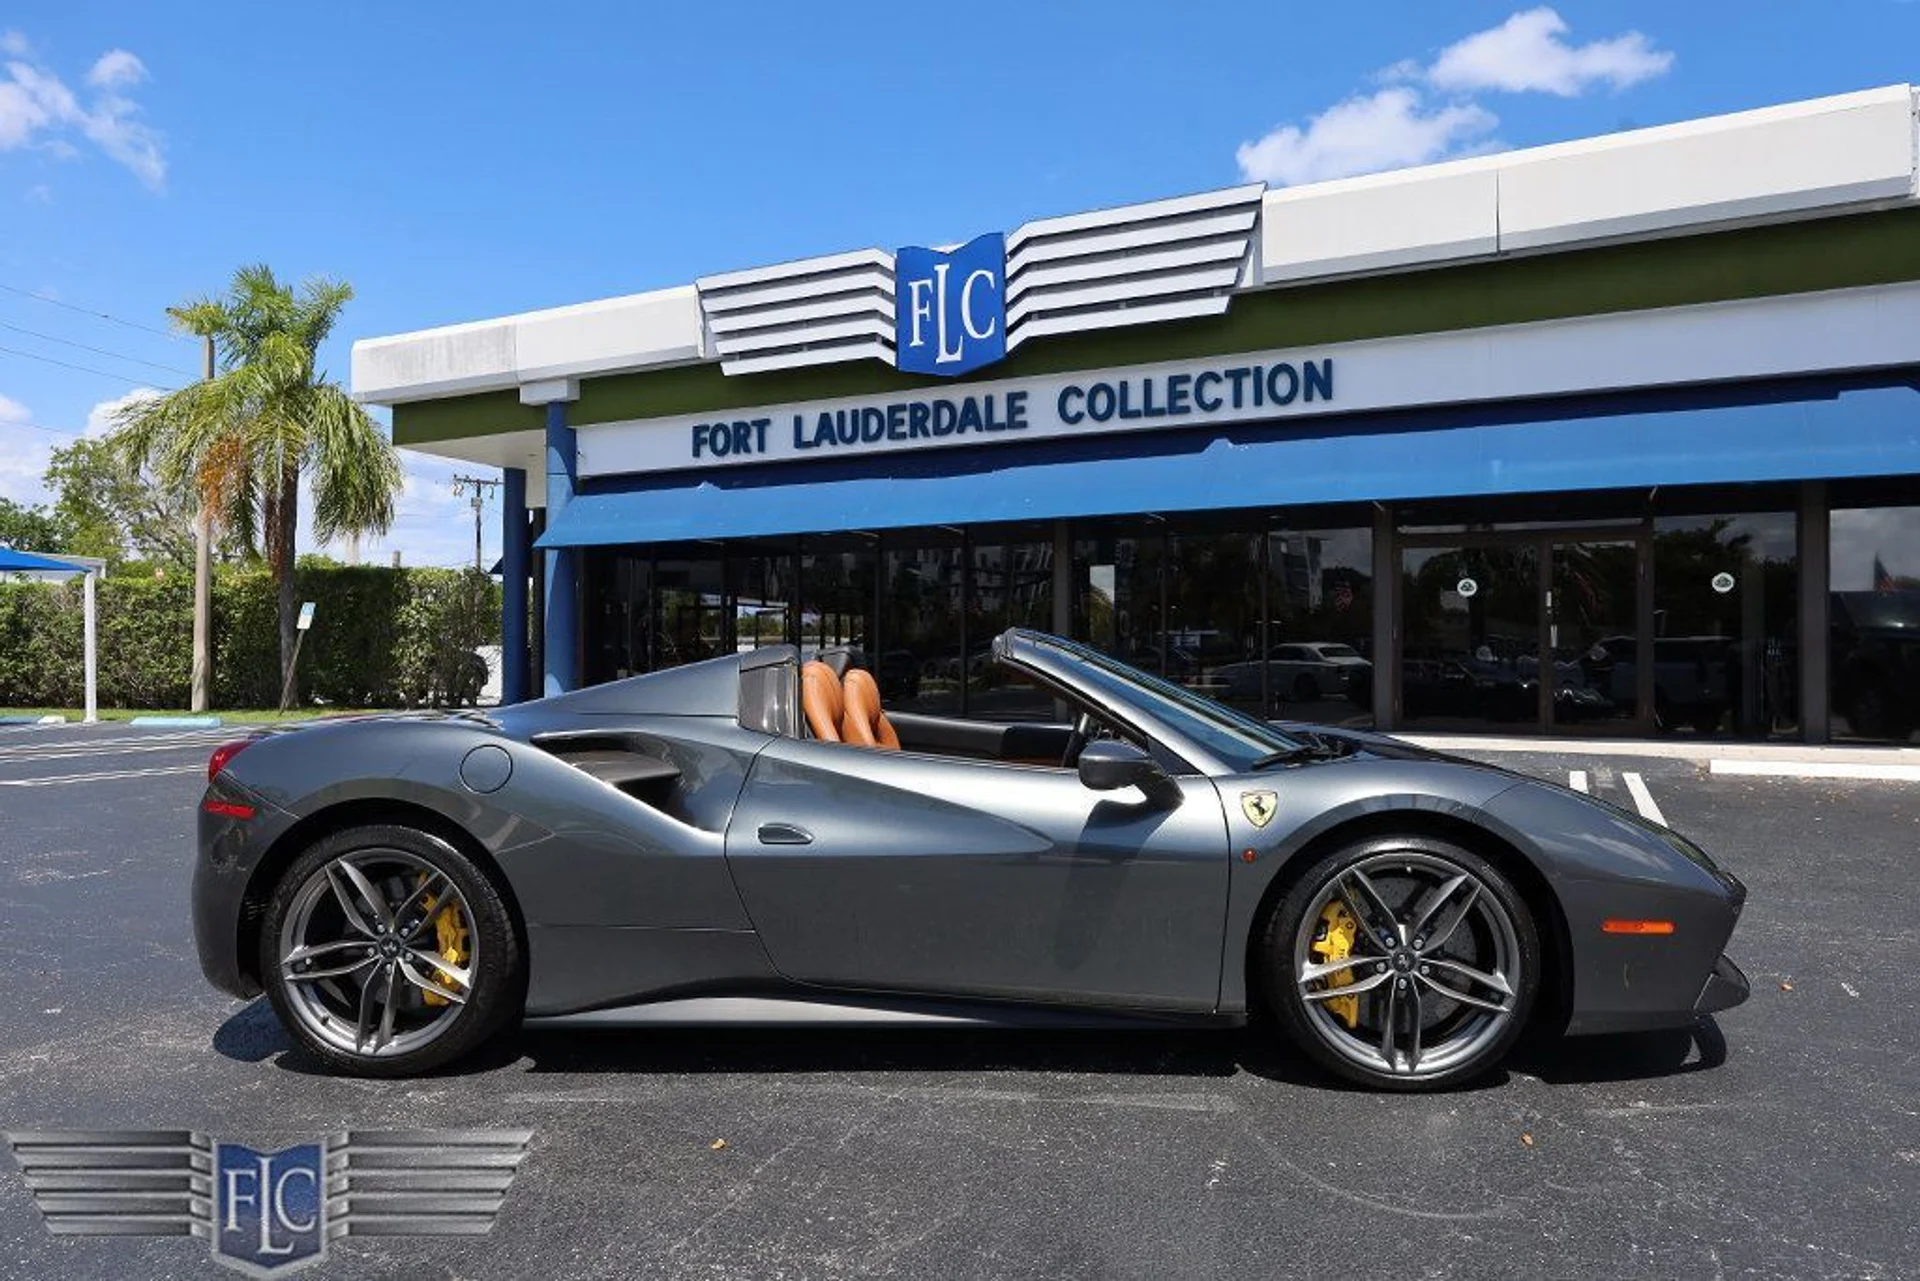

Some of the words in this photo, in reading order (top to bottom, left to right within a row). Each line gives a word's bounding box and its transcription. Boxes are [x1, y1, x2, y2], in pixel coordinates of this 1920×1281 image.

[909, 264, 995, 363] FLC
[692, 418, 771, 458] FORT
[795, 391, 1028, 449] LAUDERDALE
[1058, 358, 1333, 424] COLLECTION
